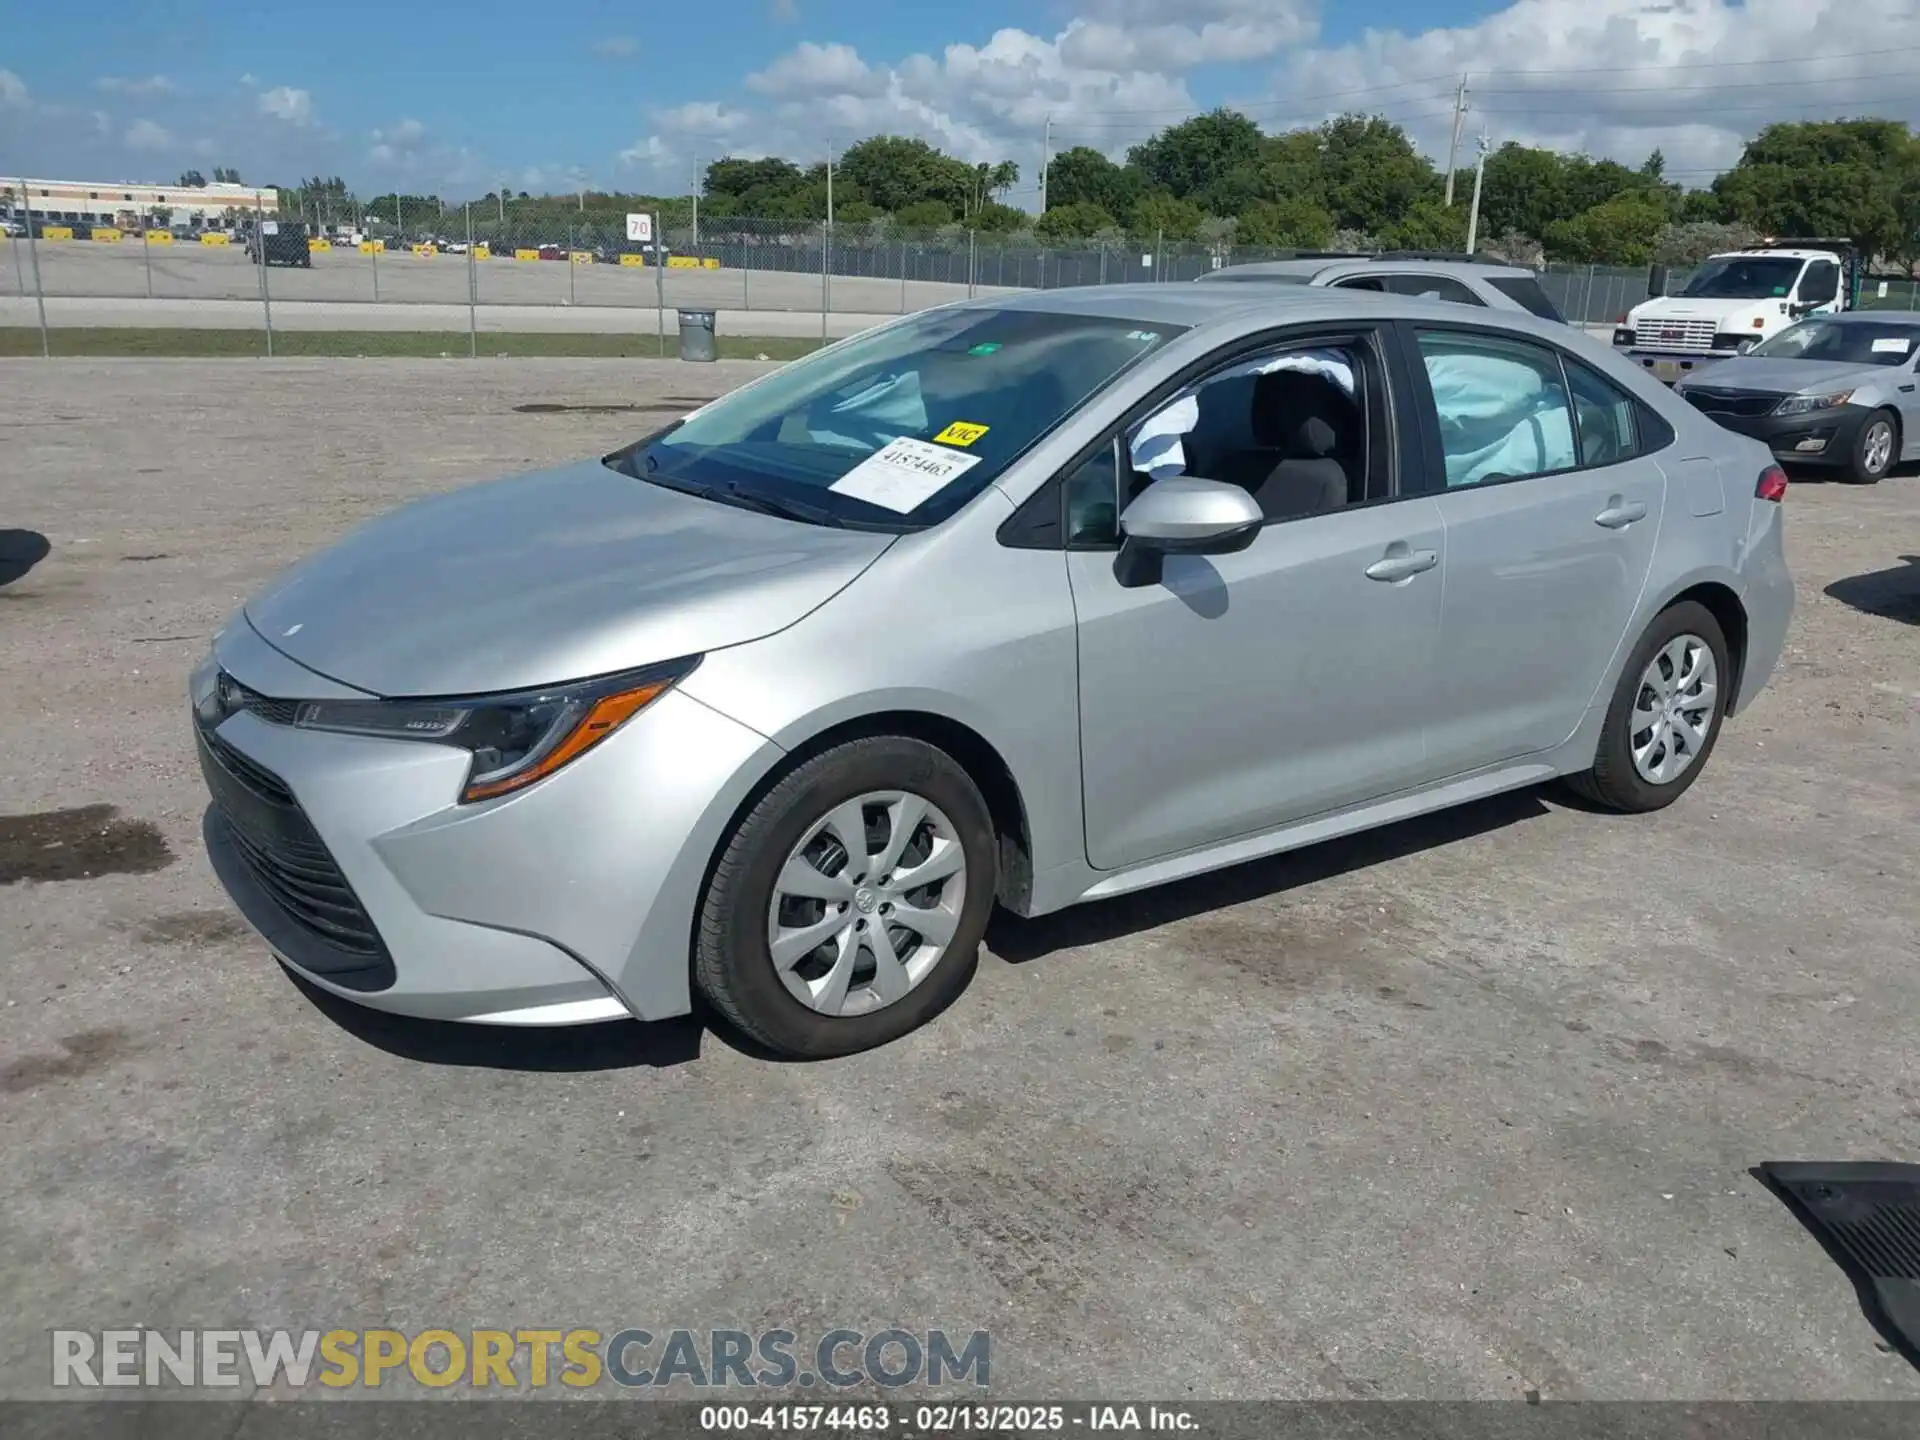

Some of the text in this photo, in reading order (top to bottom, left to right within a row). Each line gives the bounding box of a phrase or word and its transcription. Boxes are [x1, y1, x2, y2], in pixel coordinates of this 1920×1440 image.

[631, 221, 649, 235] 70
[947, 426, 980, 441] VIC
[883, 450, 953, 477] 41574463
